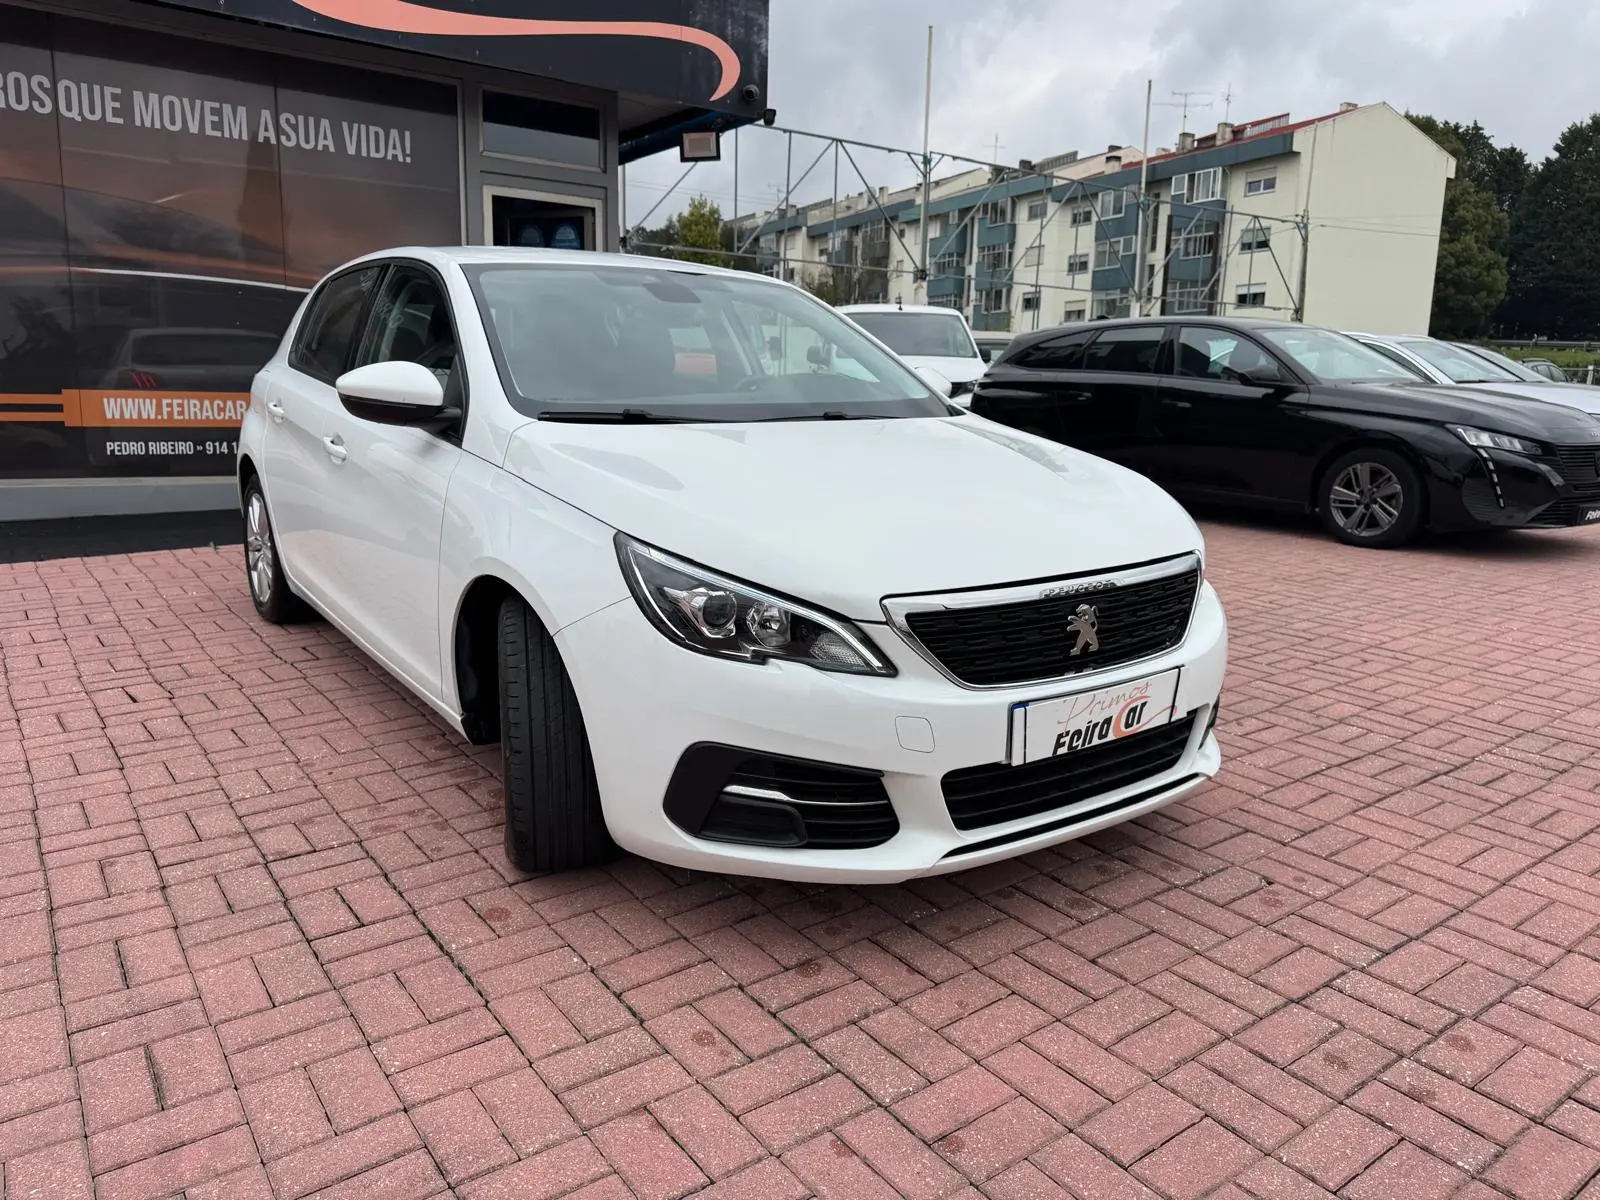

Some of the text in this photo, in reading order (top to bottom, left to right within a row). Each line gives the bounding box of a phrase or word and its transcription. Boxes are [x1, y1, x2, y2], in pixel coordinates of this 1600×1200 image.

[0, 71, 412, 163] OS QUE MOVEM A SUA VIDA!
[106, 441, 146, 456] PEDRO
[148, 441, 194, 456] RIBEIRO
[205, 441, 229, 455] 914
[1057, 681, 1153, 737] Primos
